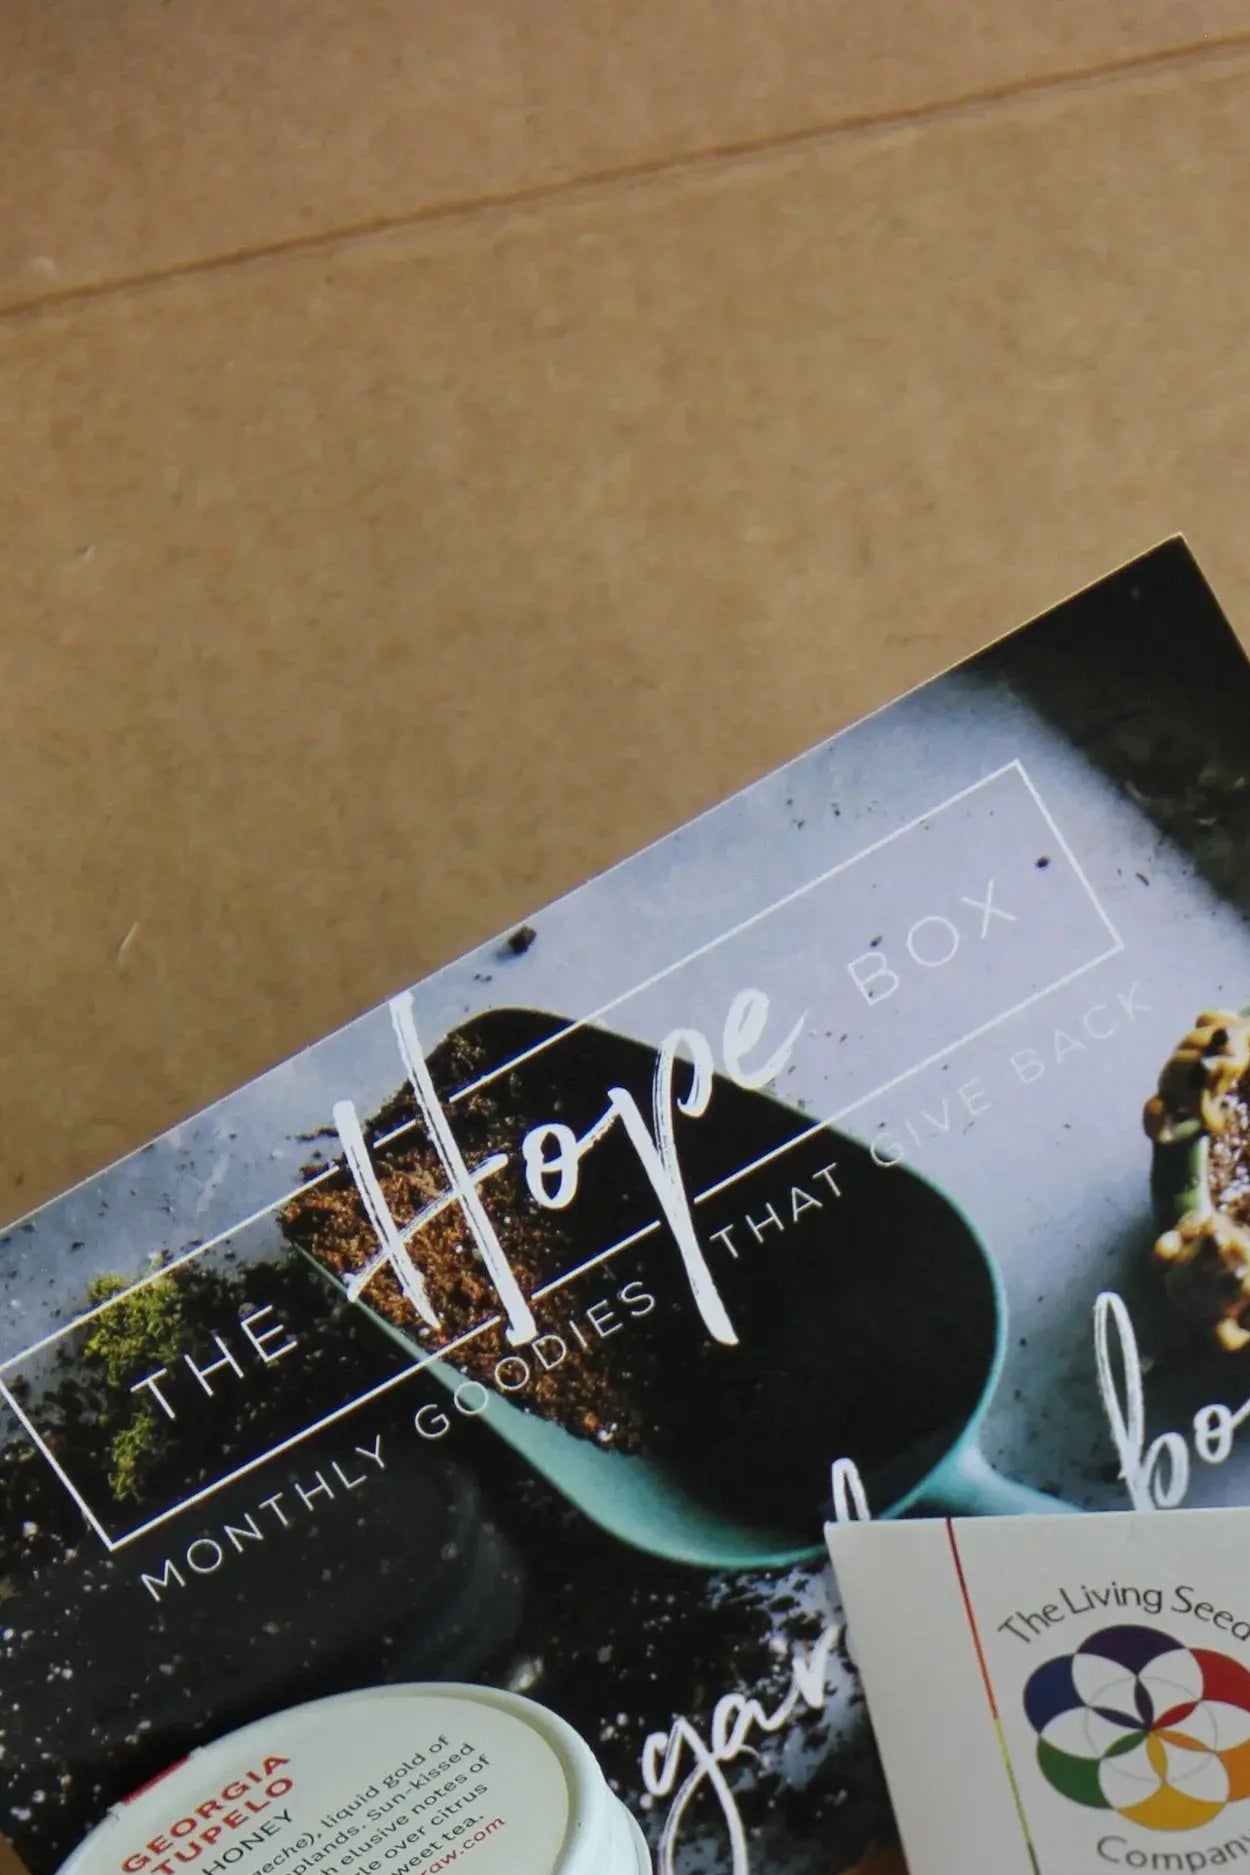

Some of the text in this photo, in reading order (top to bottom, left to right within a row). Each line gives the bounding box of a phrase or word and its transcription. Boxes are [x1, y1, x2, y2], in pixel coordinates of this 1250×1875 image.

[130, 878, 1017, 1419] THE Hope BOX
[140, 981, 1153, 1602] MONTHLY GOODIES THAT GIVE BACK
[997, 1600, 1066, 1645] The
[1058, 1580, 1164, 1615] Living
[121, 1756, 291, 1874] GEORGIA
[320, 1785, 380, 1829] liquid
[382, 1753, 426, 1789] gold
[429, 1734, 451, 1754] of
[340, 1816, 409, 1866] elusive
[411, 1774, 468, 1815] notes
[469, 1753, 492, 1774] of
[367, 1742, 475, 1822] Sun-kissed
[384, 1826, 427, 1860] over
[430, 1783, 488, 1826] citrus
[442, 1814, 485, 1842] tea.
